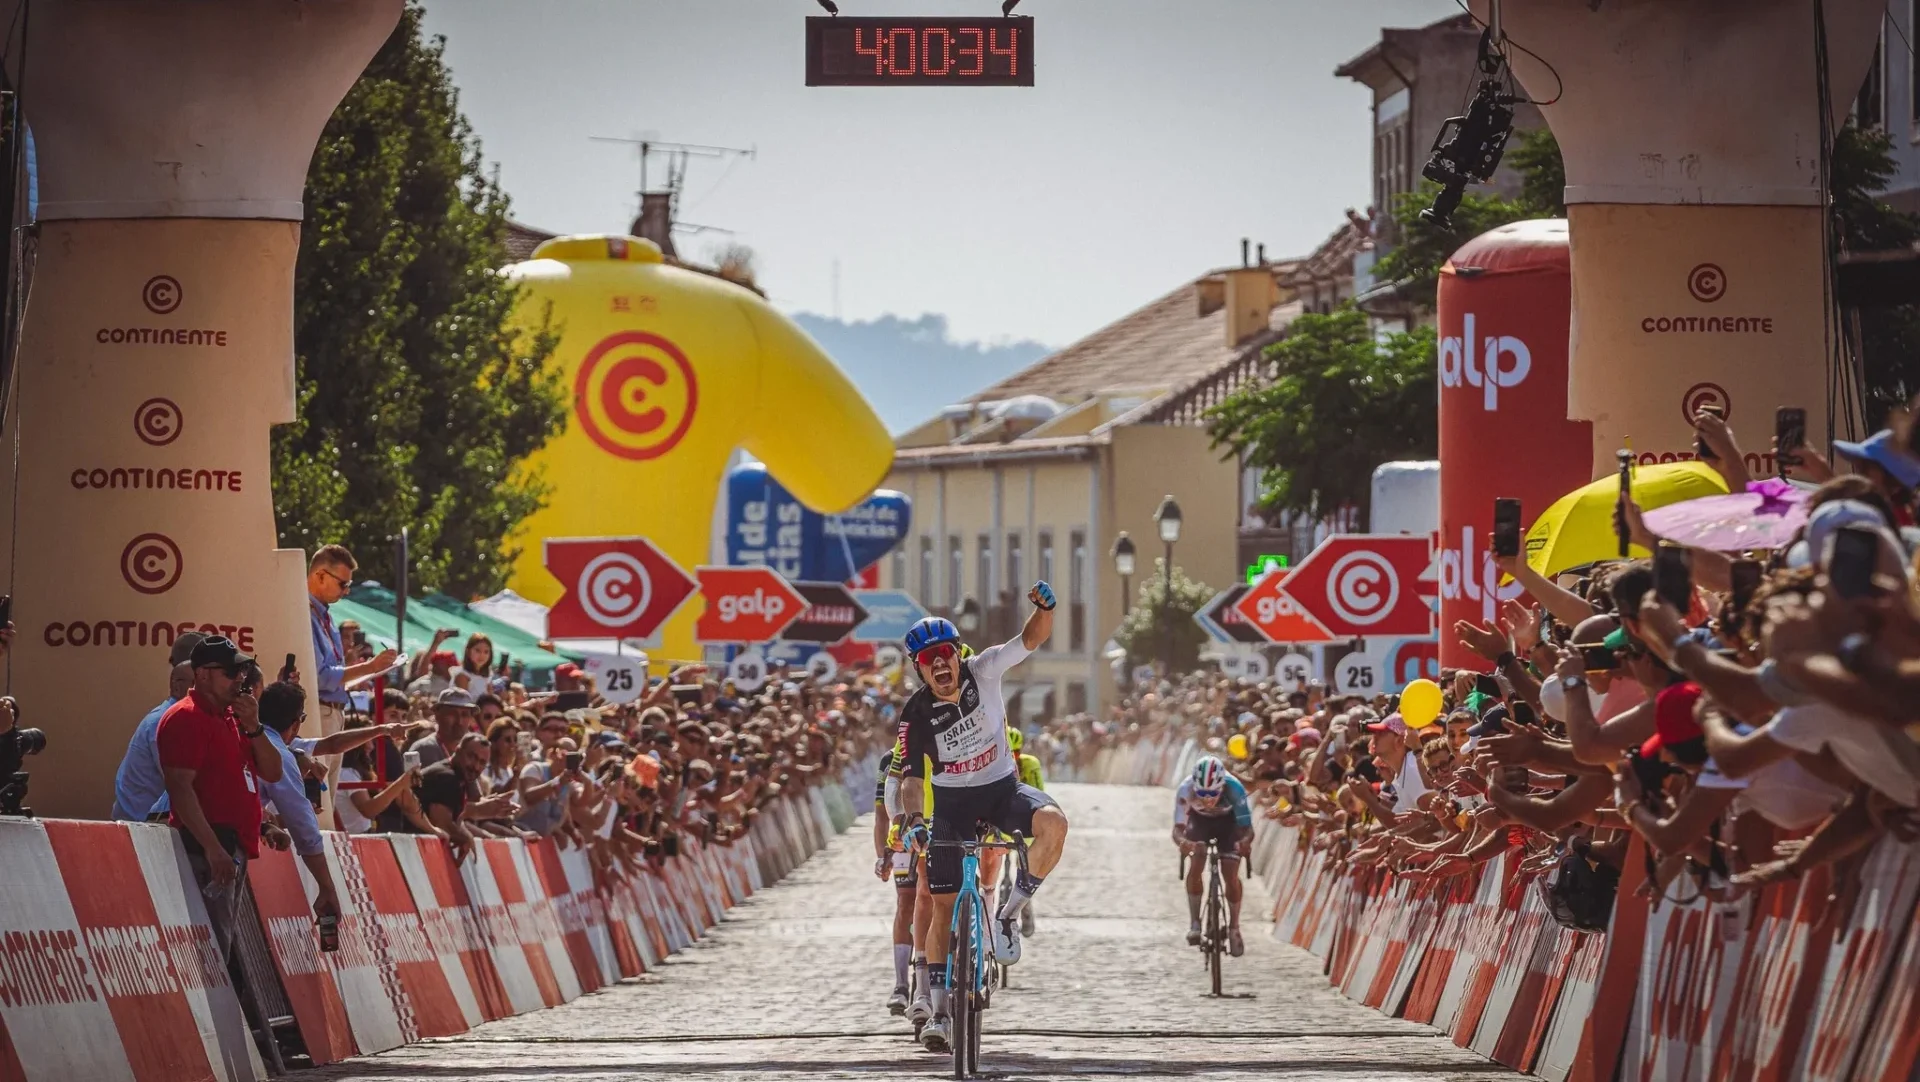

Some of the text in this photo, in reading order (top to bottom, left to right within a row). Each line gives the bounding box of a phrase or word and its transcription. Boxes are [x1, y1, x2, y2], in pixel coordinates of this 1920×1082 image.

[856, 28, 1017, 75] 4:00:34
[97, 328, 228, 347] CONTINENTE
[1642, 316, 1773, 334] CONTINENTE
[1437, 312, 1532, 411] alp
[71, 467, 242, 492] CONTINENTE
[1437, 526, 1528, 624] alp
[718, 587, 785, 623] galp
[606, 669, 633, 691] 25
[738, 664, 758, 680] 50
[1347, 666, 1373, 688] 25
[943, 717, 977, 742] ISRAEL
[944, 747, 997, 774] PLACARD
